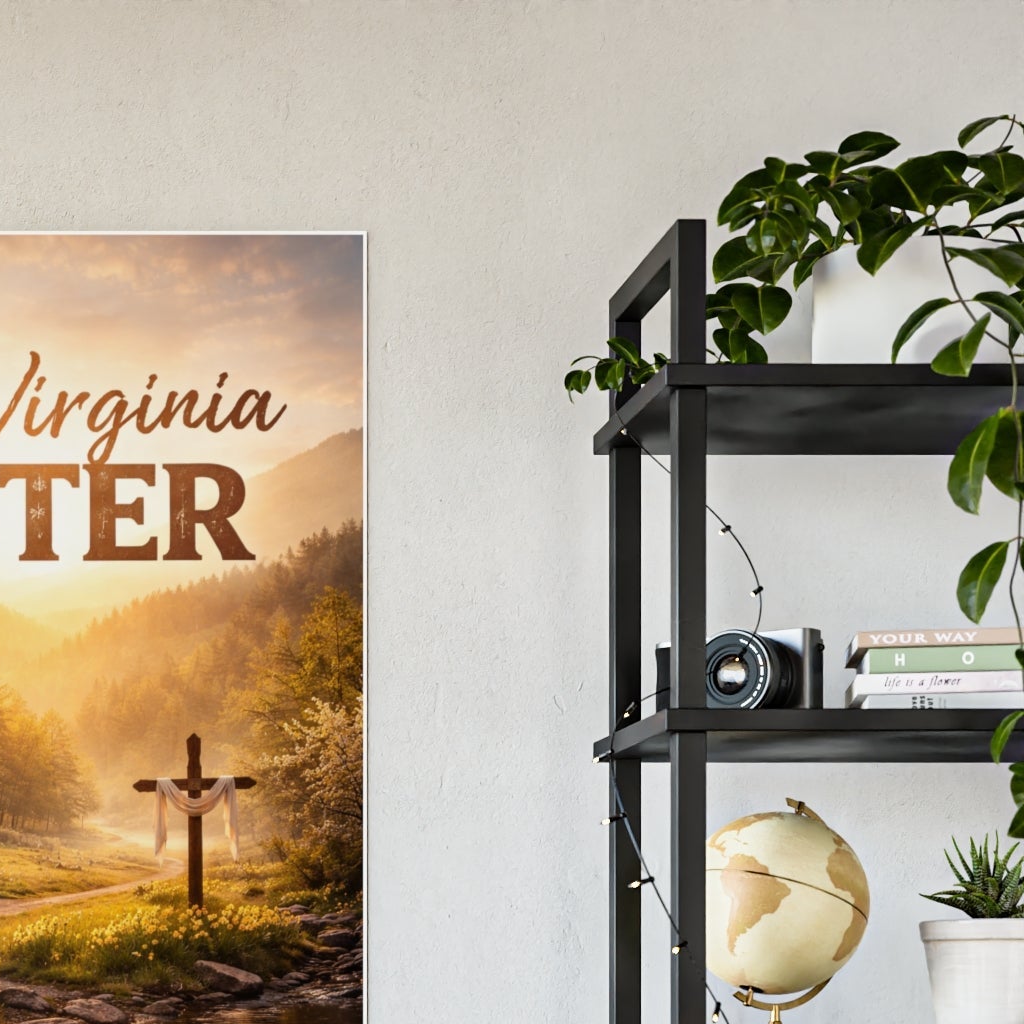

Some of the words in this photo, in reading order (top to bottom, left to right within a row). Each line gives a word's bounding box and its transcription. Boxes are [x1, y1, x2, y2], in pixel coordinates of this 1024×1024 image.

[870, 633, 928, 645] YOUR
[934, 632, 977, 642] WAY
[884, 676, 901, 691] life
[905, 678, 914, 686] is
[926, 675, 961, 690] flower
